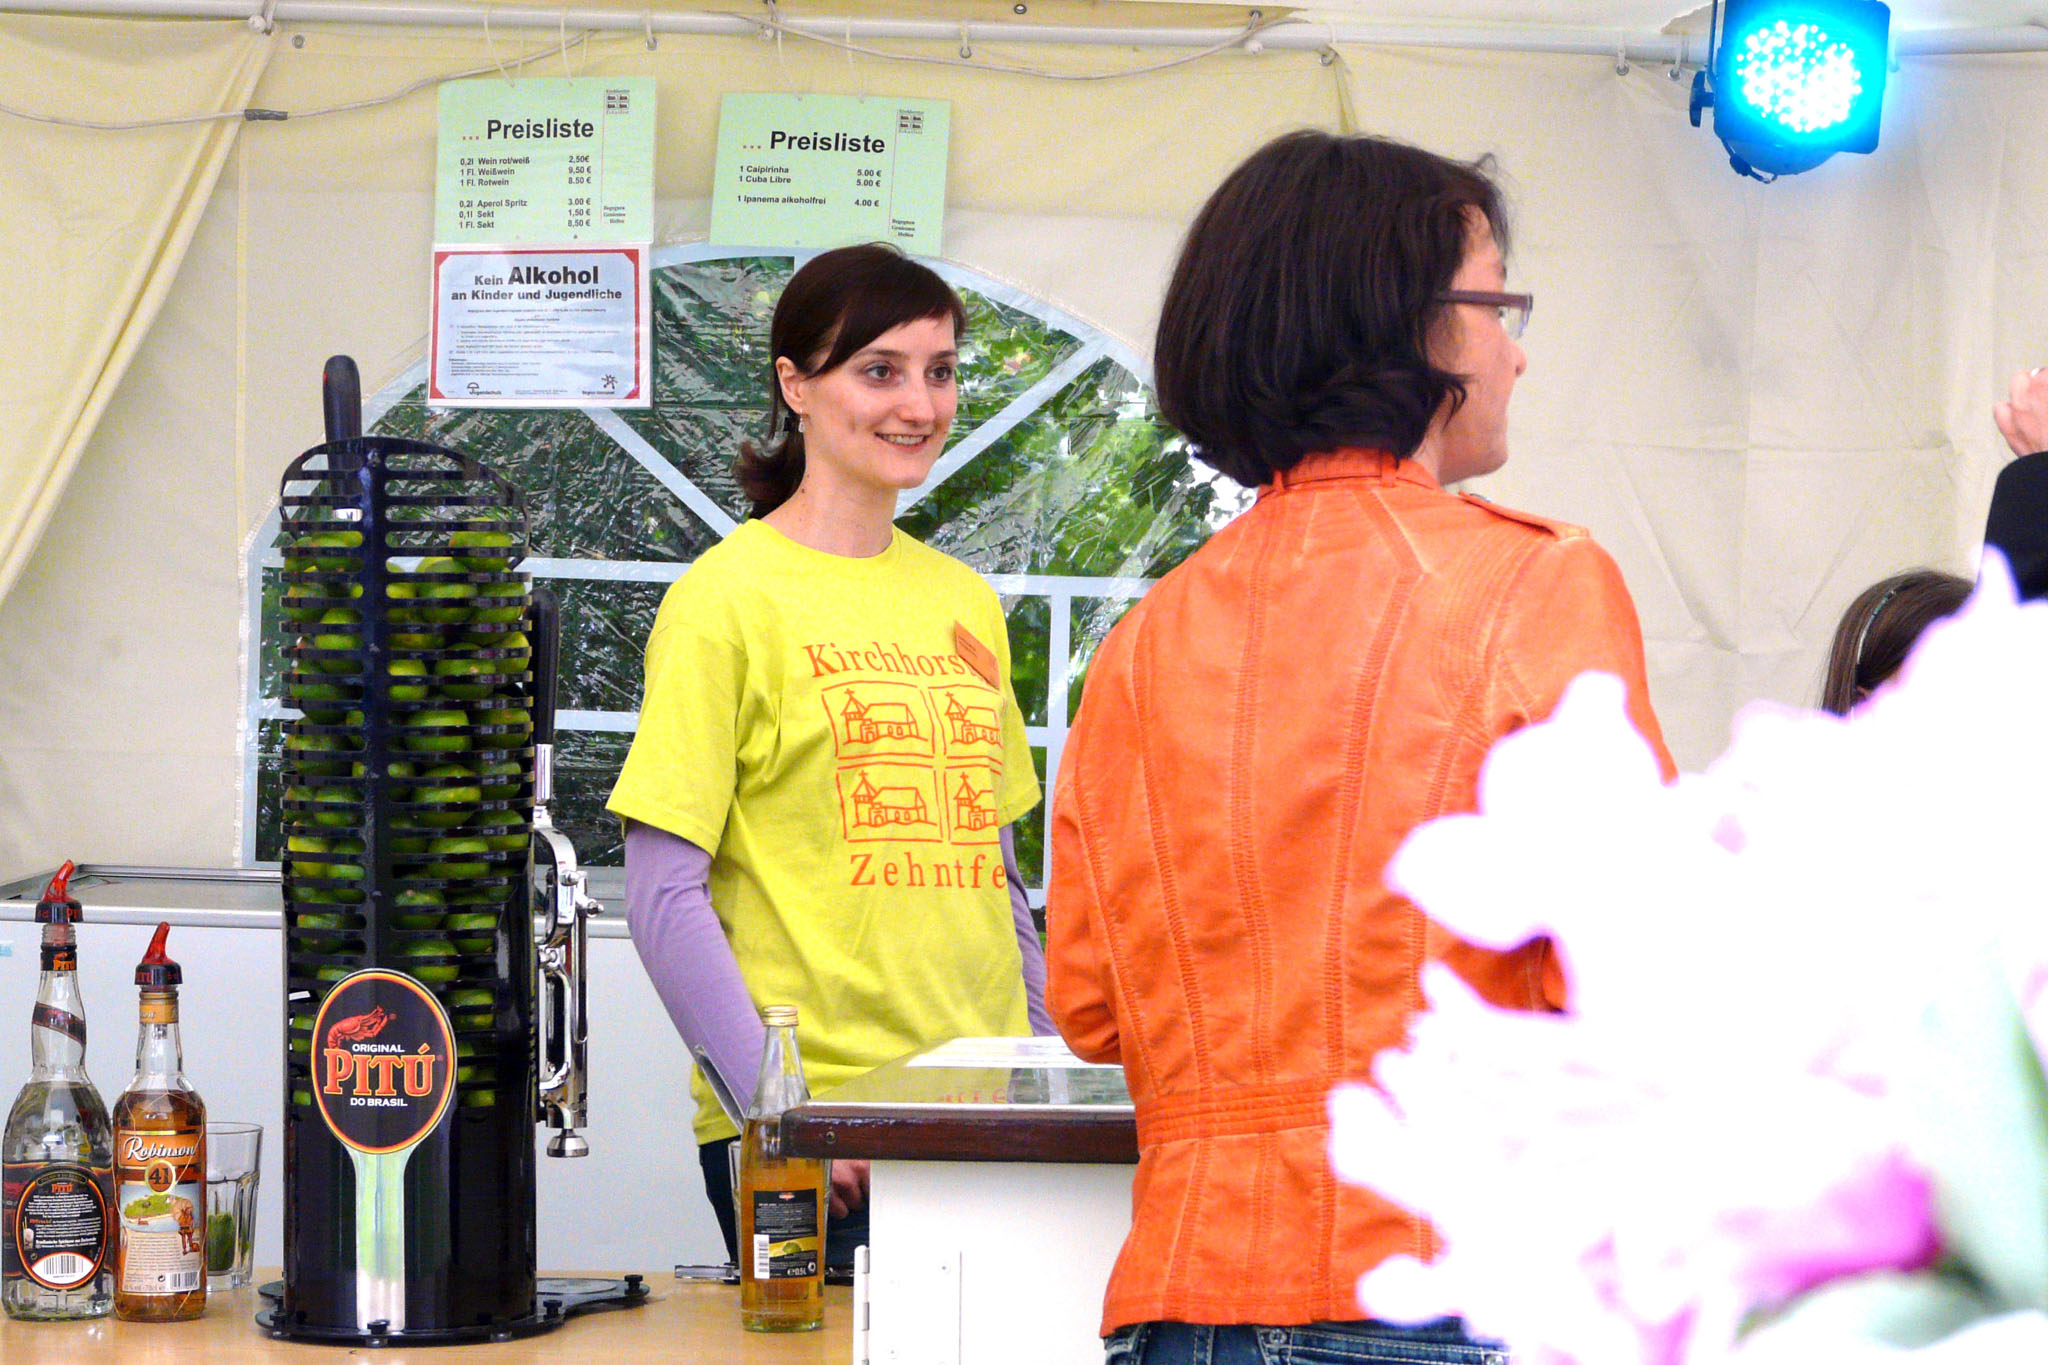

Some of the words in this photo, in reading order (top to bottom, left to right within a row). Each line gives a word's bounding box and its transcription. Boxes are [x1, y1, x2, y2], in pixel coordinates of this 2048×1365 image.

[486, 118, 594, 140] Preisliste
[770, 131, 885, 154] Preisliste
[478, 157, 497, 165] Wein
[746, 166, 789, 174] Caipirinha
[477, 200, 503, 208] Aperol
[505, 199, 528, 208] Spritz
[744, 195, 779, 204] Ipanema
[782, 196, 826, 204] alkoholfrei
[474, 274, 503, 286] Kein
[508, 266, 599, 285] Alkohol
[451, 291, 467, 300] an
[471, 289, 513, 300] Kinder
[517, 289, 541, 300] und
[545, 288, 622, 301] Jugendliche
[352, 1043, 405, 1053] ORIGINAL
[323, 1043, 435, 1097] PITÚ
[350, 1098, 366, 1106] DO
[367, 1098, 408, 1107] BRASIL
[124, 1136, 195, 1162] Robinson
[149, 1168, 170, 1184] 41
